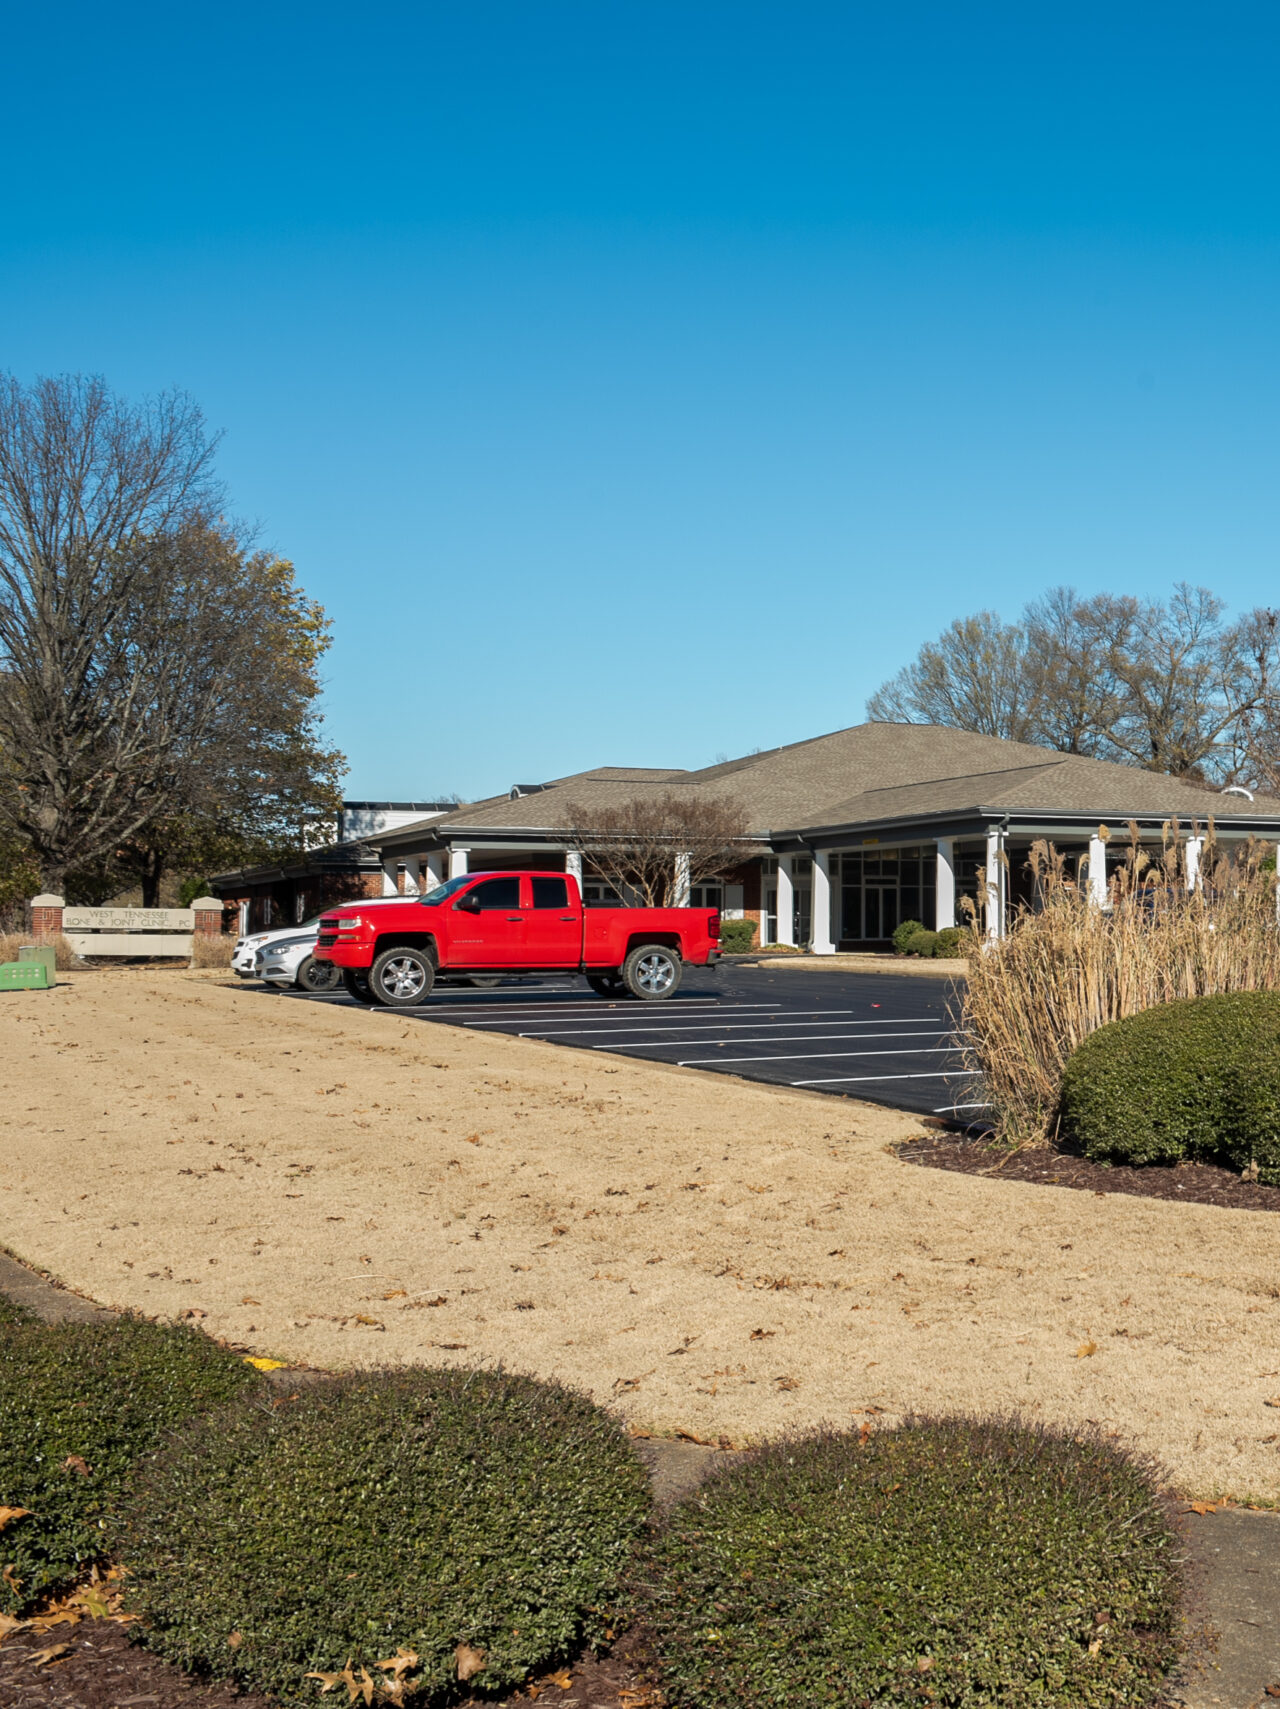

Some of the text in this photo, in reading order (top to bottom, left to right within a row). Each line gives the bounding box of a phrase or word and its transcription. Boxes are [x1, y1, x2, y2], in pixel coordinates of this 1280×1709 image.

[89, 910, 169, 919] WEST TENNESSEE
[112, 918, 135, 927] JOINT
[179, 920, 191, 928] PC
